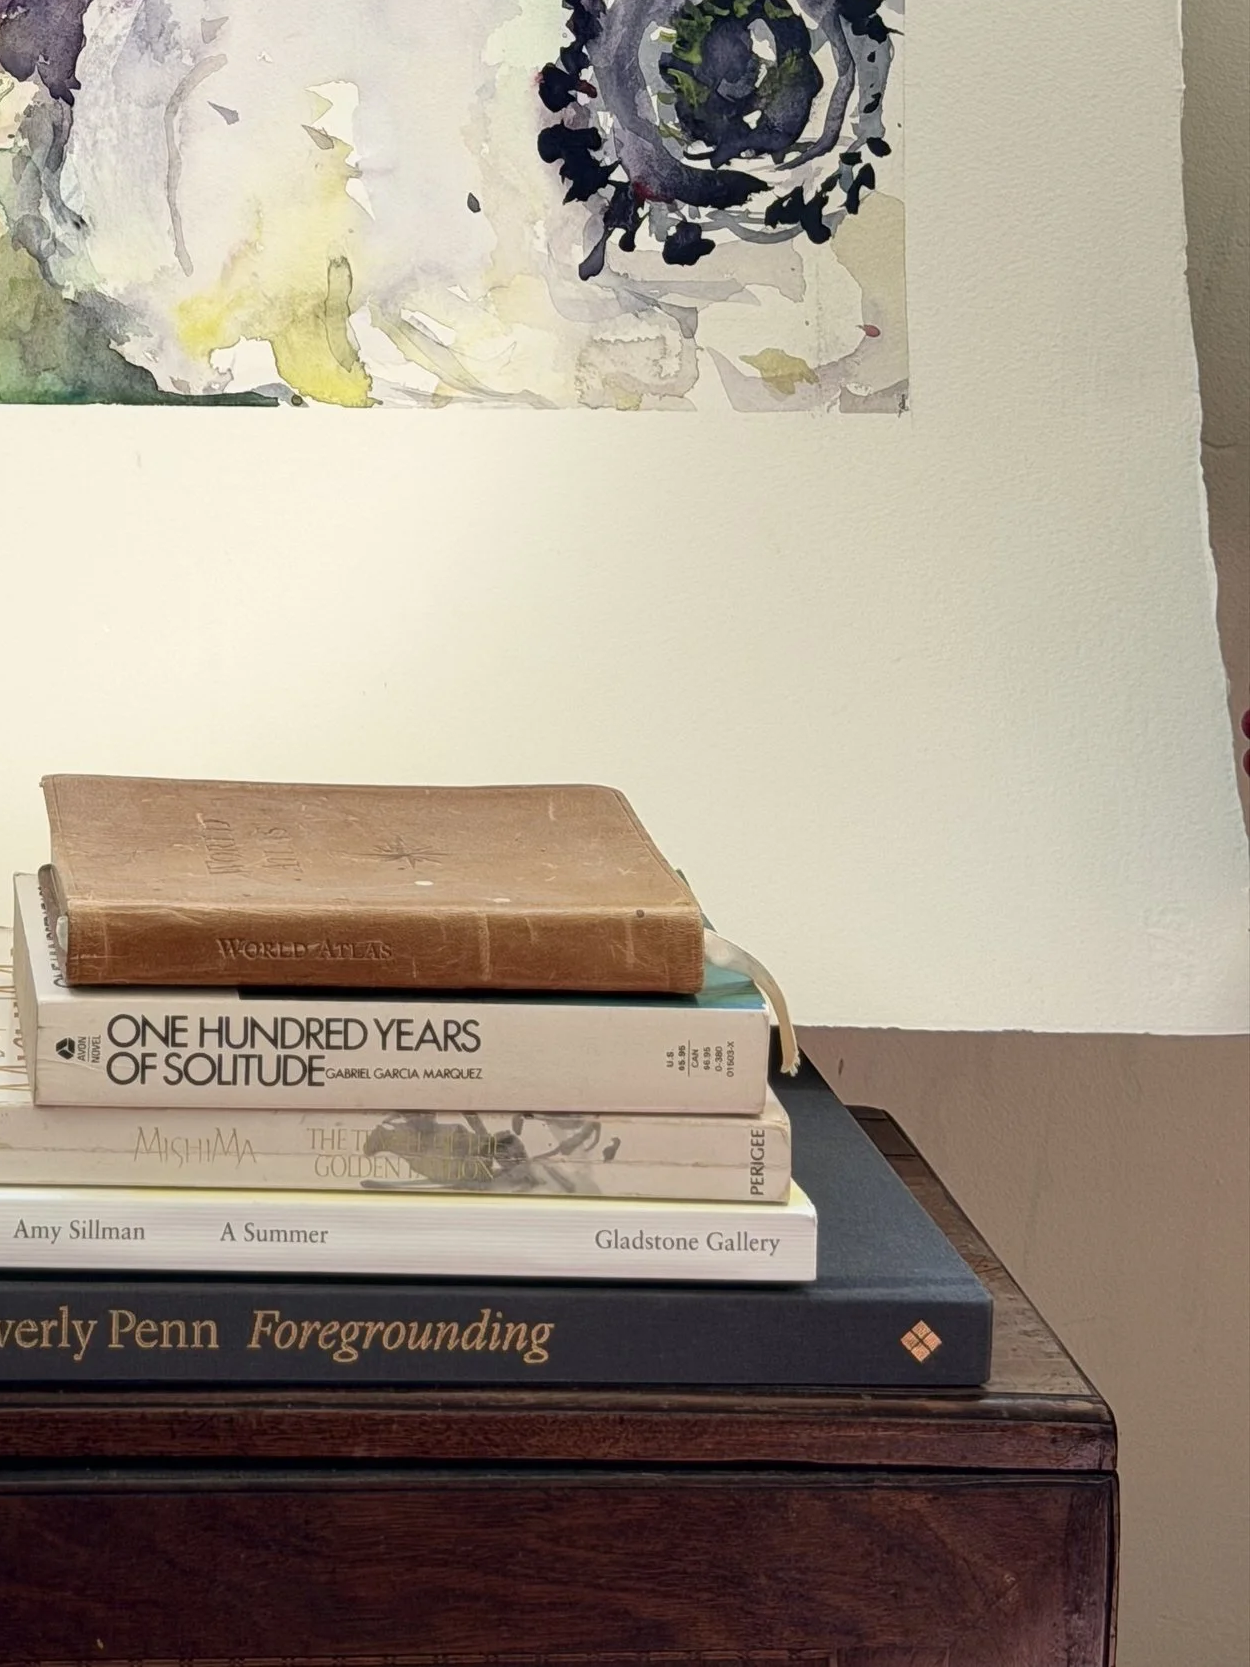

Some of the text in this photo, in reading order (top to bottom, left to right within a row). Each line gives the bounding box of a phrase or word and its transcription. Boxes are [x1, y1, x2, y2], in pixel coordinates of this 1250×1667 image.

[216, 937, 394, 961] WORLD ATLAS
[107, 1014, 482, 1054] ONE HUNDRED YEARS
[77, 1036, 88, 1062] AVON
[91, 1034, 102, 1064] NOVEL
[691, 1048, 700, 1069] CAN
[106, 1052, 326, 1088] OF SOLITUDE
[325, 1066, 483, 1081] GABRIEL GARCIA MARQUEZ
[133, 1126, 257, 1169] MISHIMA
[306, 1127, 348, 1152] THE
[314, 1154, 402, 1179] GOLDEN
[750, 1129, 766, 1196] PERIGEE
[12, 1218, 146, 1245] Amy Sillman
[219, 1222, 330, 1245] A Summer
[594, 1228, 781, 1257] Gladstone Gallery
[107, 1309, 220, 1350] Penn
[247, 1308, 555, 1364] Foregrounding
